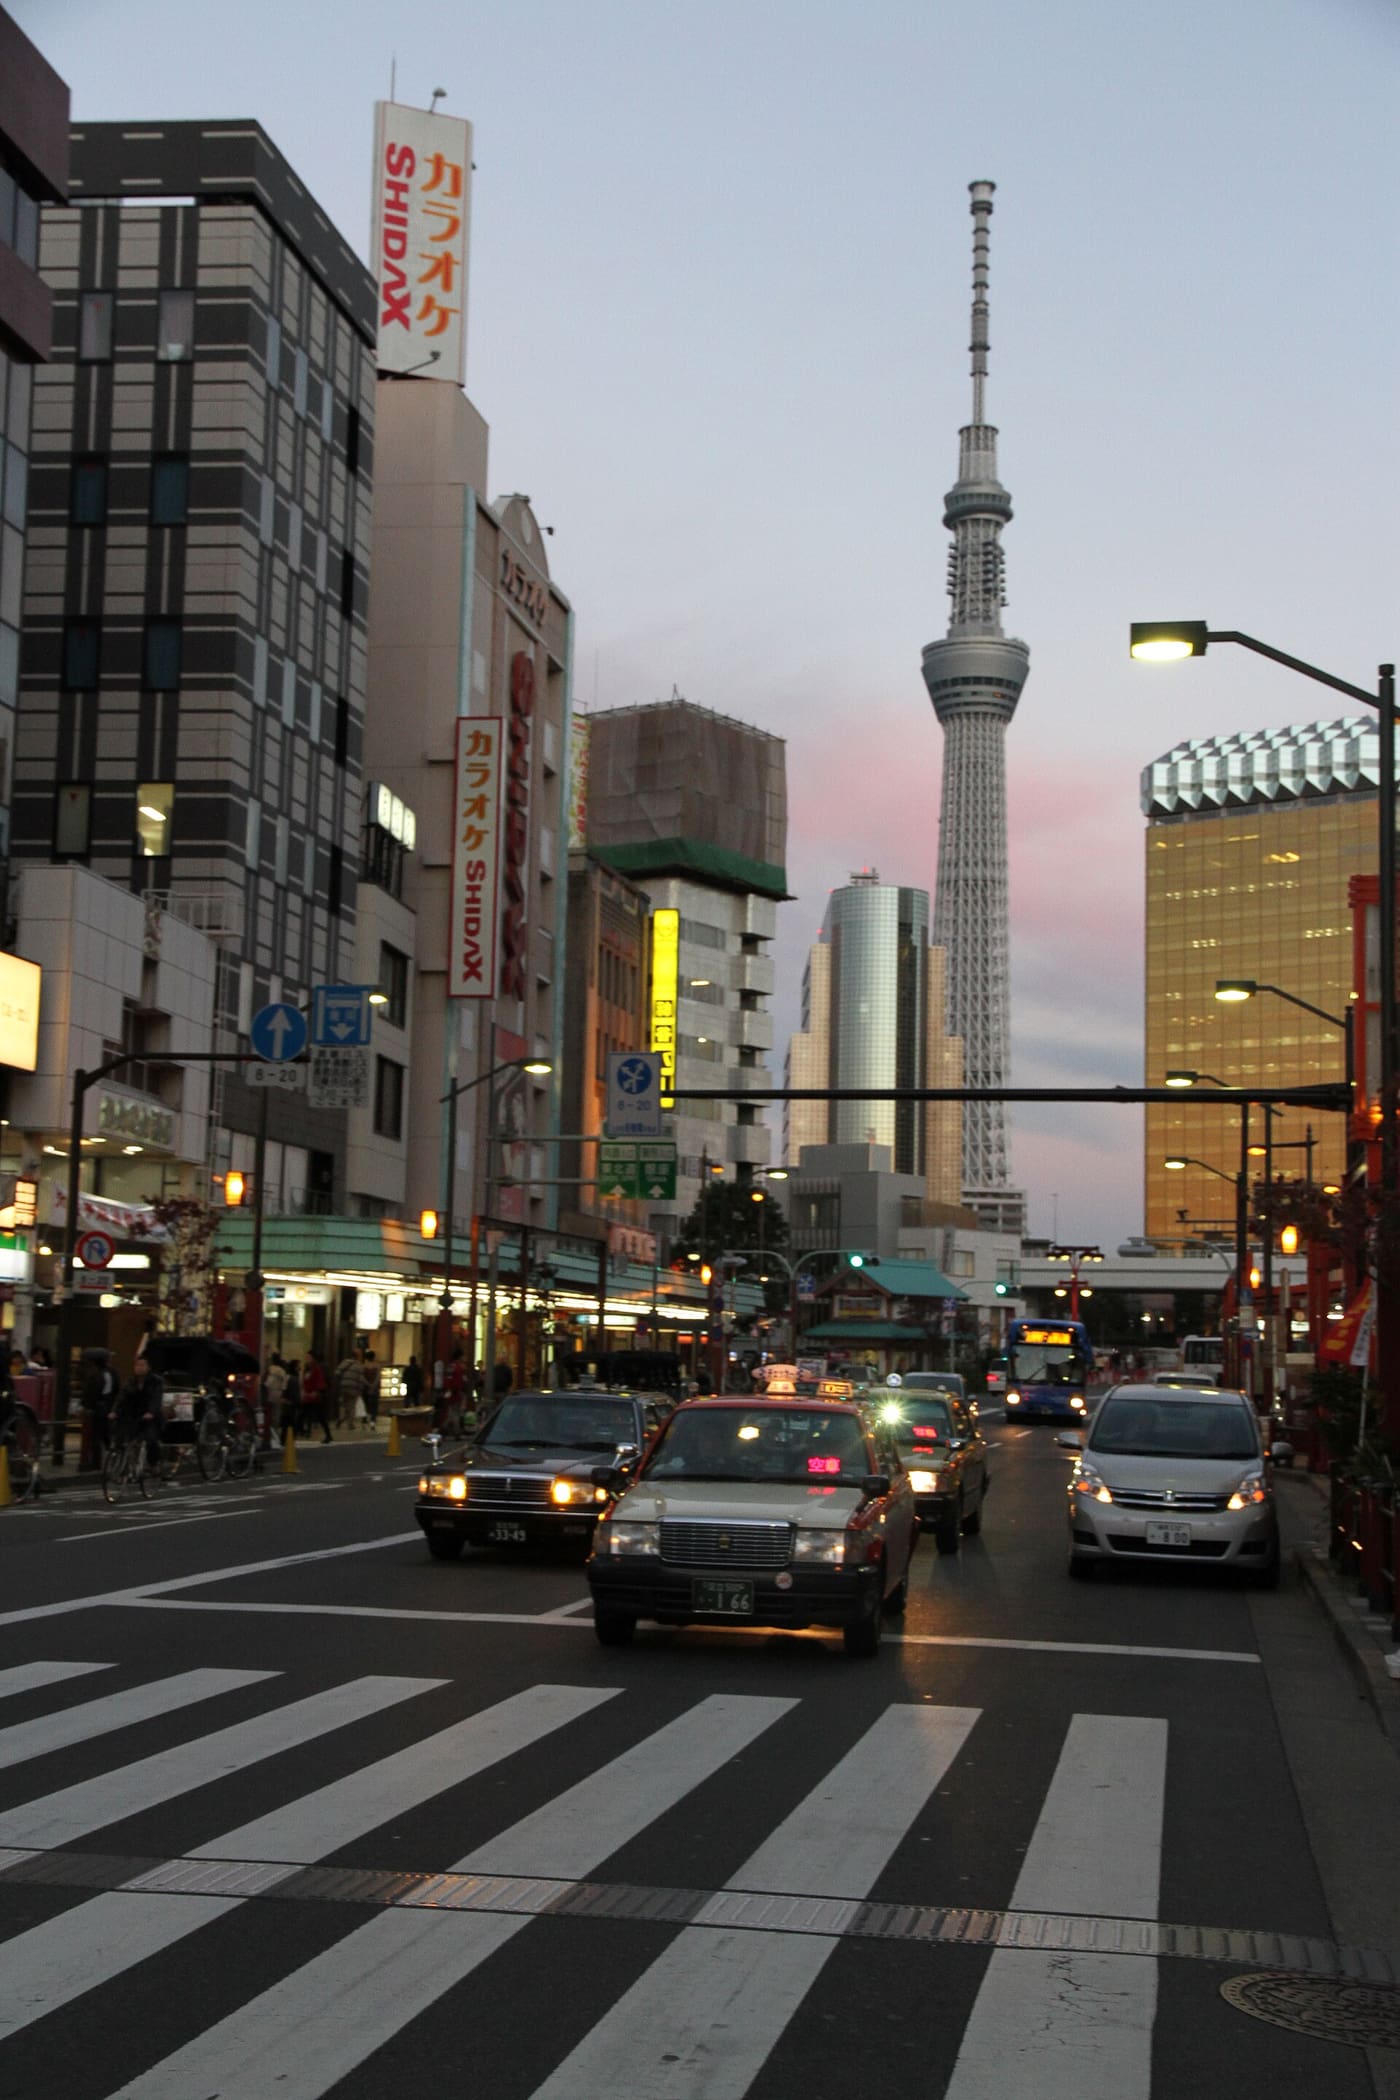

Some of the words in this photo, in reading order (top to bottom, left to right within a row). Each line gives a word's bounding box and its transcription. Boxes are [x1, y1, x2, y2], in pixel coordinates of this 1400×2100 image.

[382, 141, 416, 332] SHIDAX
[417, 152, 462, 337] カラオケ
[462, 730, 491, 852] カラオケ
[462, 860, 487, 983] SHIDAX
